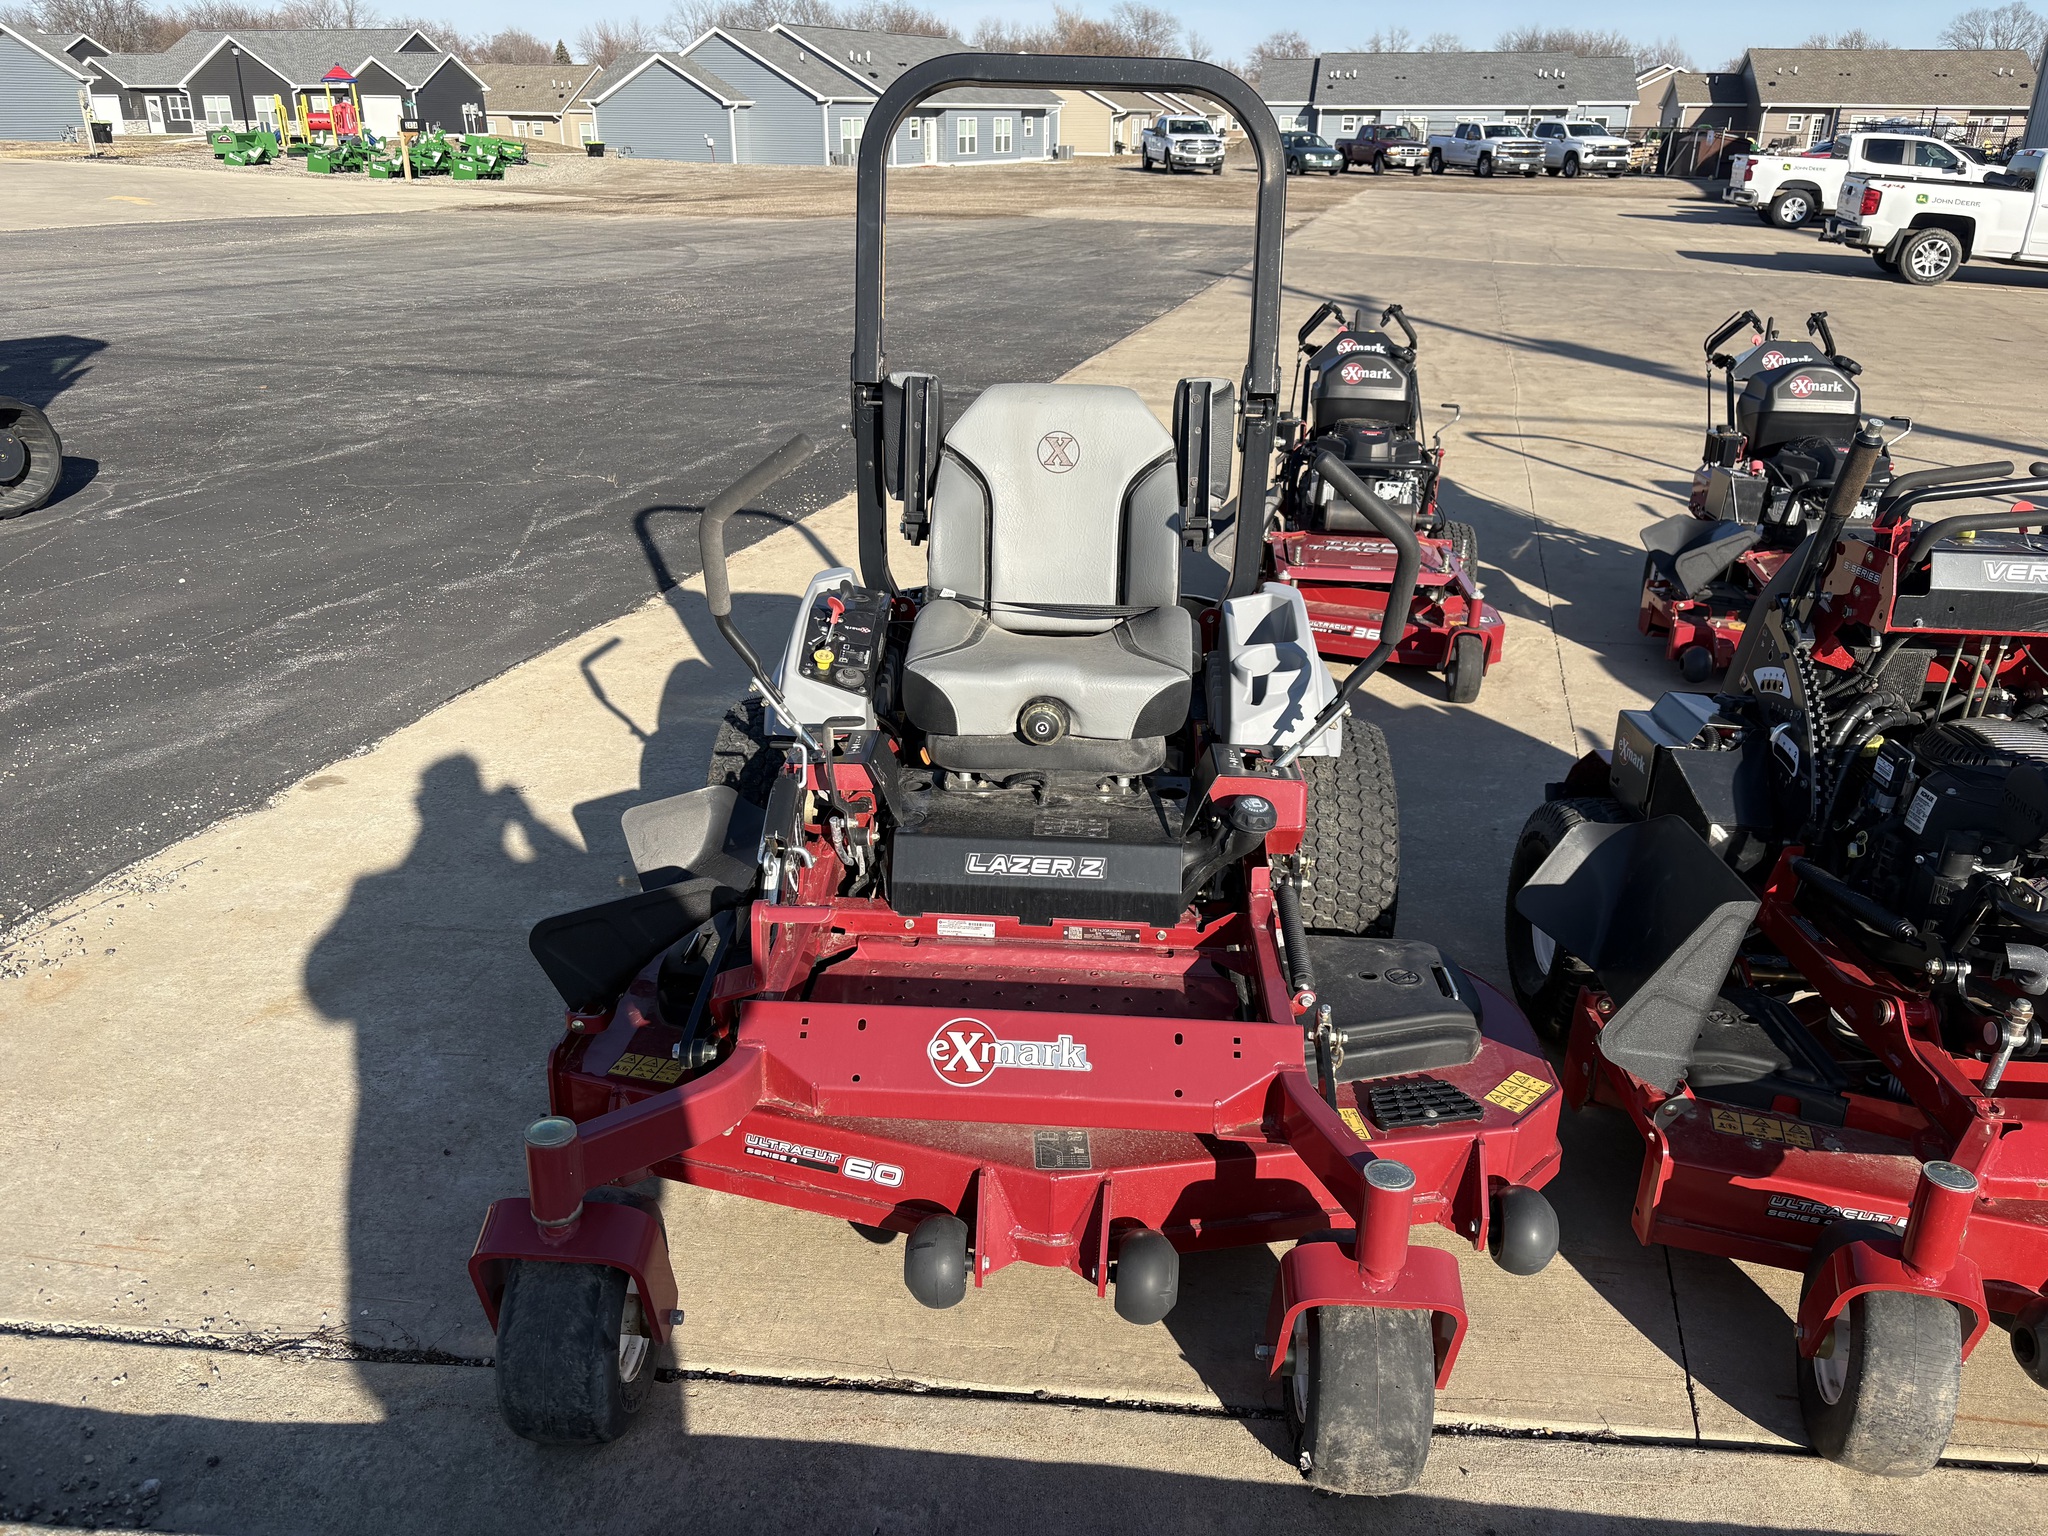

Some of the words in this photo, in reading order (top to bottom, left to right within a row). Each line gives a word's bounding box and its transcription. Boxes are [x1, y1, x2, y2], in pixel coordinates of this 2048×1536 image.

[1932, 197, 1954, 205] JOHN
[1954, 198, 1982, 208] DEERE
[1340, 365, 1392, 381] eXmark
[1789, 379, 1844, 395] eXmark
[1043, 436, 1074, 467] X
[1306, 544, 1398, 554] TRACE
[1842, 559, 1881, 585] S-SERIES
[1352, 626, 1381, 641] 36
[965, 852, 1076, 879] LAZER
[1077, 856, 1106, 879] Z
[928, 1028, 1091, 1076] eXmark
[745, 1133, 842, 1164] ULTRACUT
[842, 1156, 904, 1188] 60
[746, 1147, 787, 1162] SERIES
[1768, 1195, 1891, 1222] ULTRACUT
[1767, 1209, 1820, 1225] SERIES
